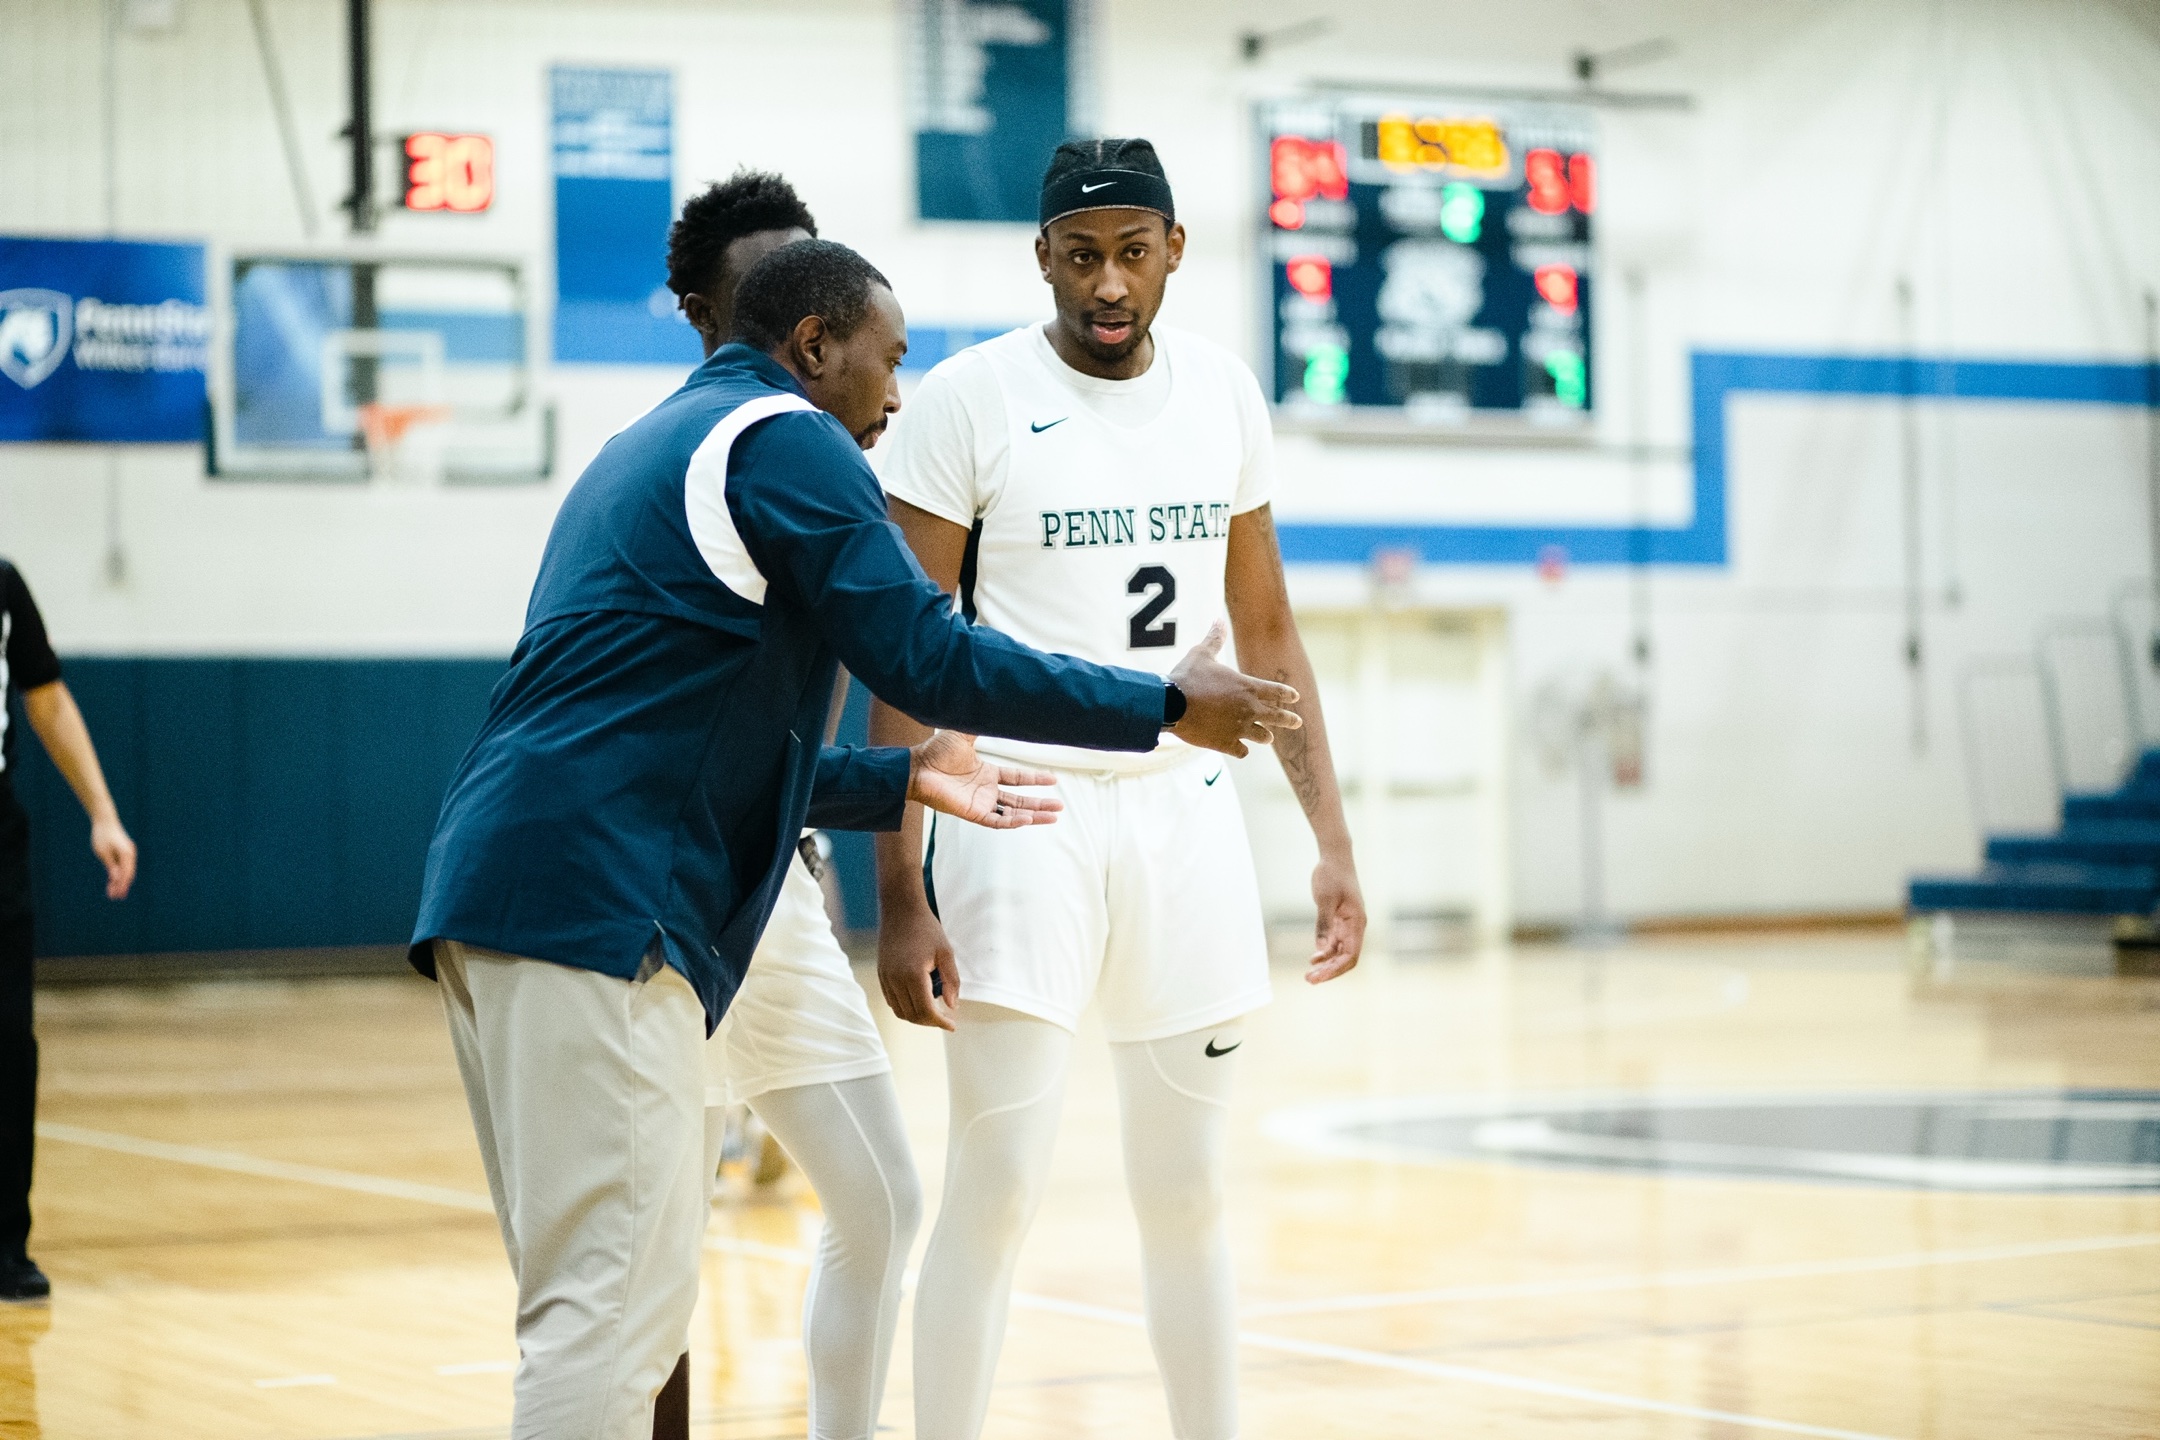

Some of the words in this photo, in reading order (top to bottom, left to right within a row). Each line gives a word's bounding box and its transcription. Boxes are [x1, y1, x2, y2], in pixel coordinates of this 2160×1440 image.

[405, 132, 496, 213] 30
[1041, 507, 1136, 549] PENN
[1125, 562, 1178, 651] 2
